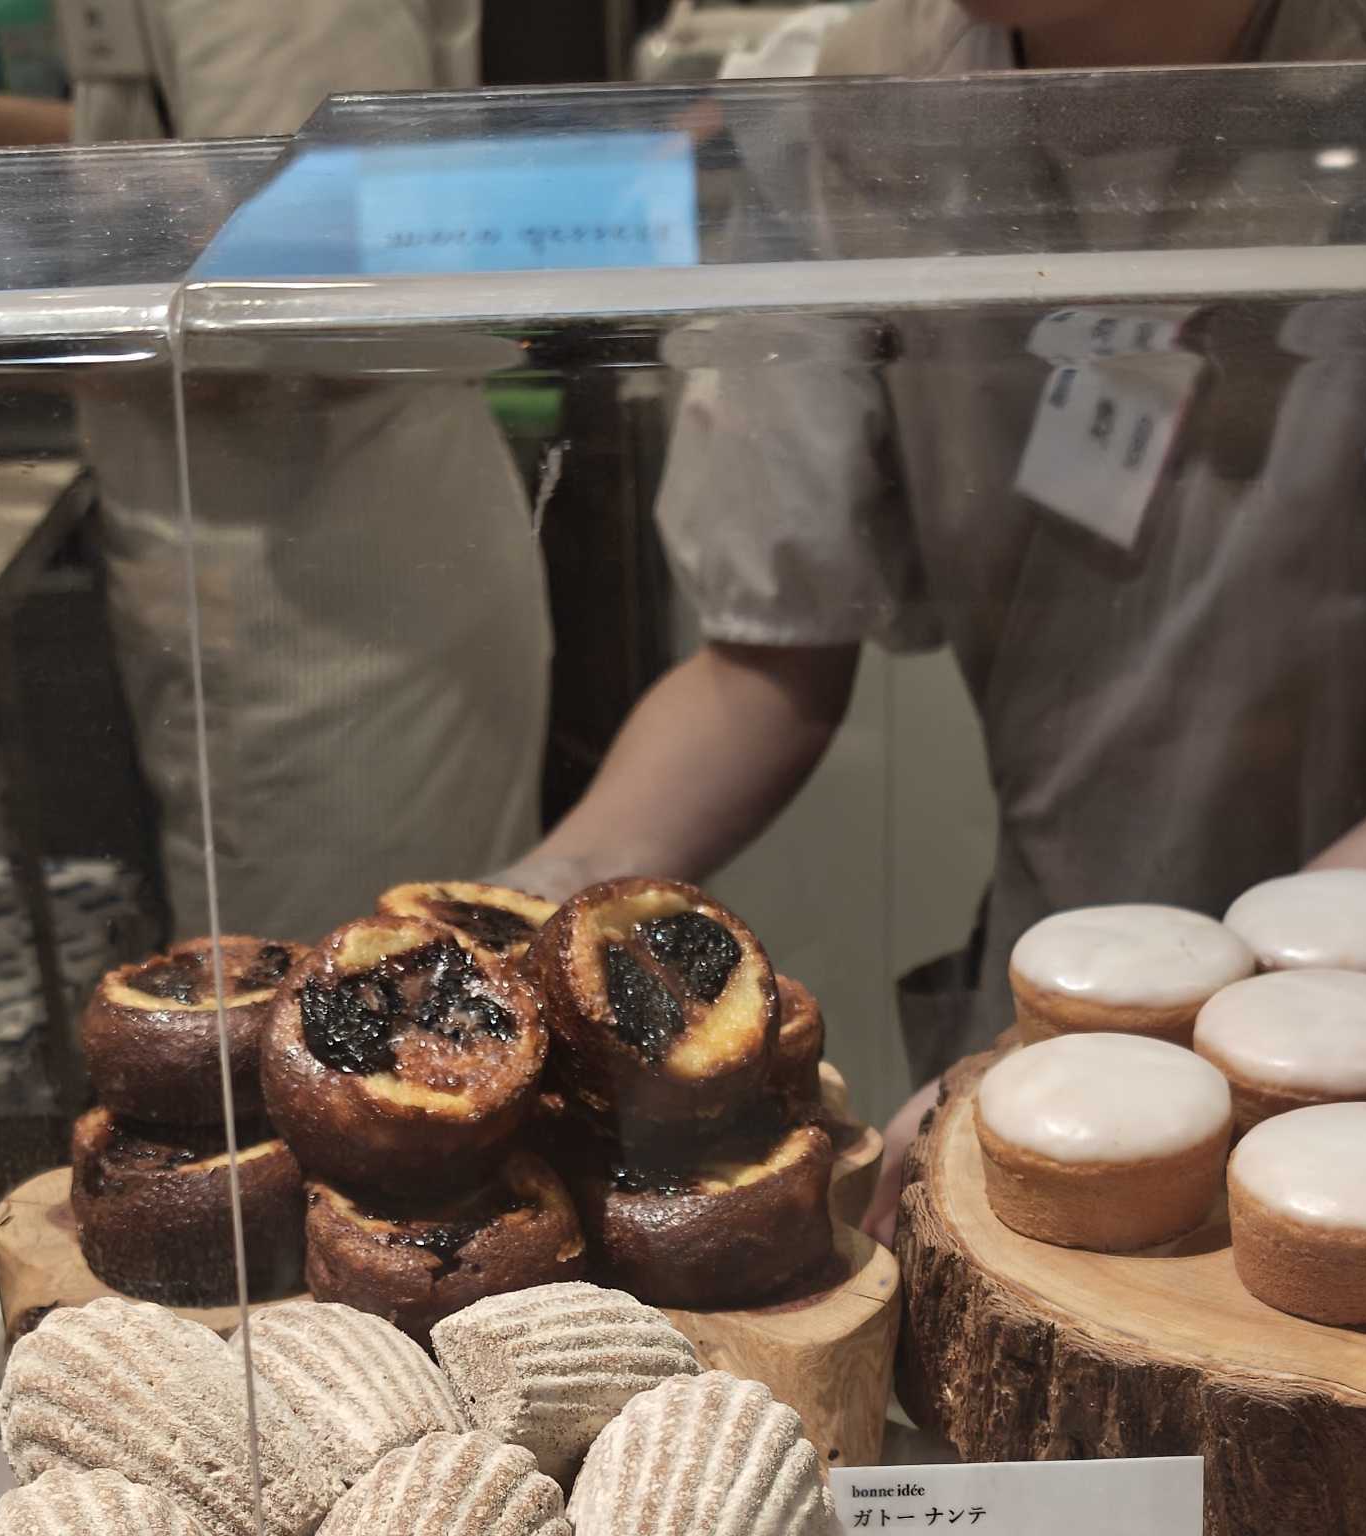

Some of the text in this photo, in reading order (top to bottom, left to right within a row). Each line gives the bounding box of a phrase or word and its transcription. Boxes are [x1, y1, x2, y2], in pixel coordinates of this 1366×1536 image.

[852, 1484, 925, 1497] bonne idée
[854, 1507, 986, 1527] ガトー ナンテ
